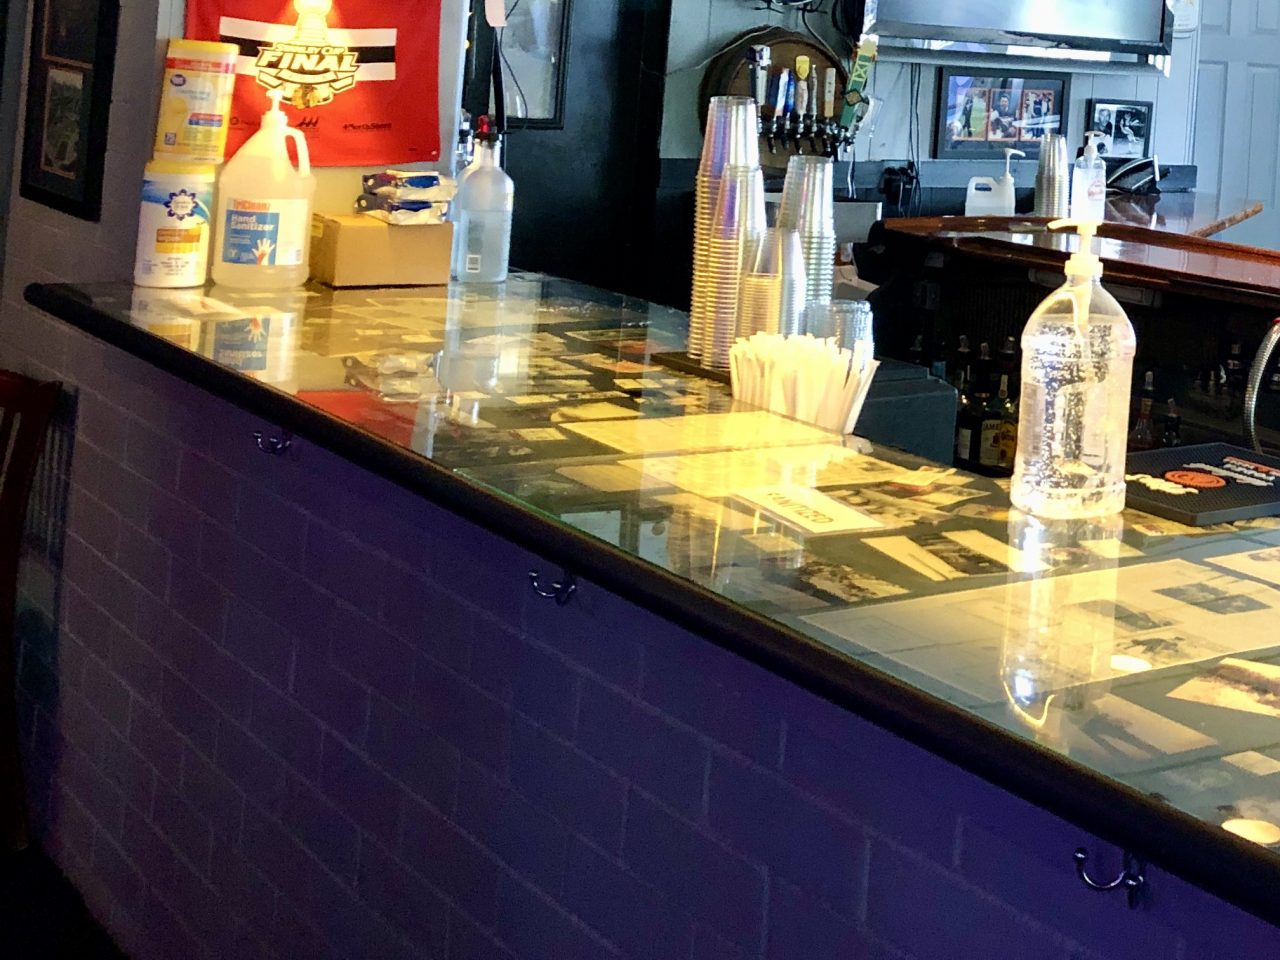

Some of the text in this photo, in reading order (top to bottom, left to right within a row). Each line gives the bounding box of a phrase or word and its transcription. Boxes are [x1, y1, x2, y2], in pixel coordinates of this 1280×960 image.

[257, 49, 360, 72] FINAL
[232, 214, 256, 223] Hand
[231, 222, 275, 231] Sanitizer
